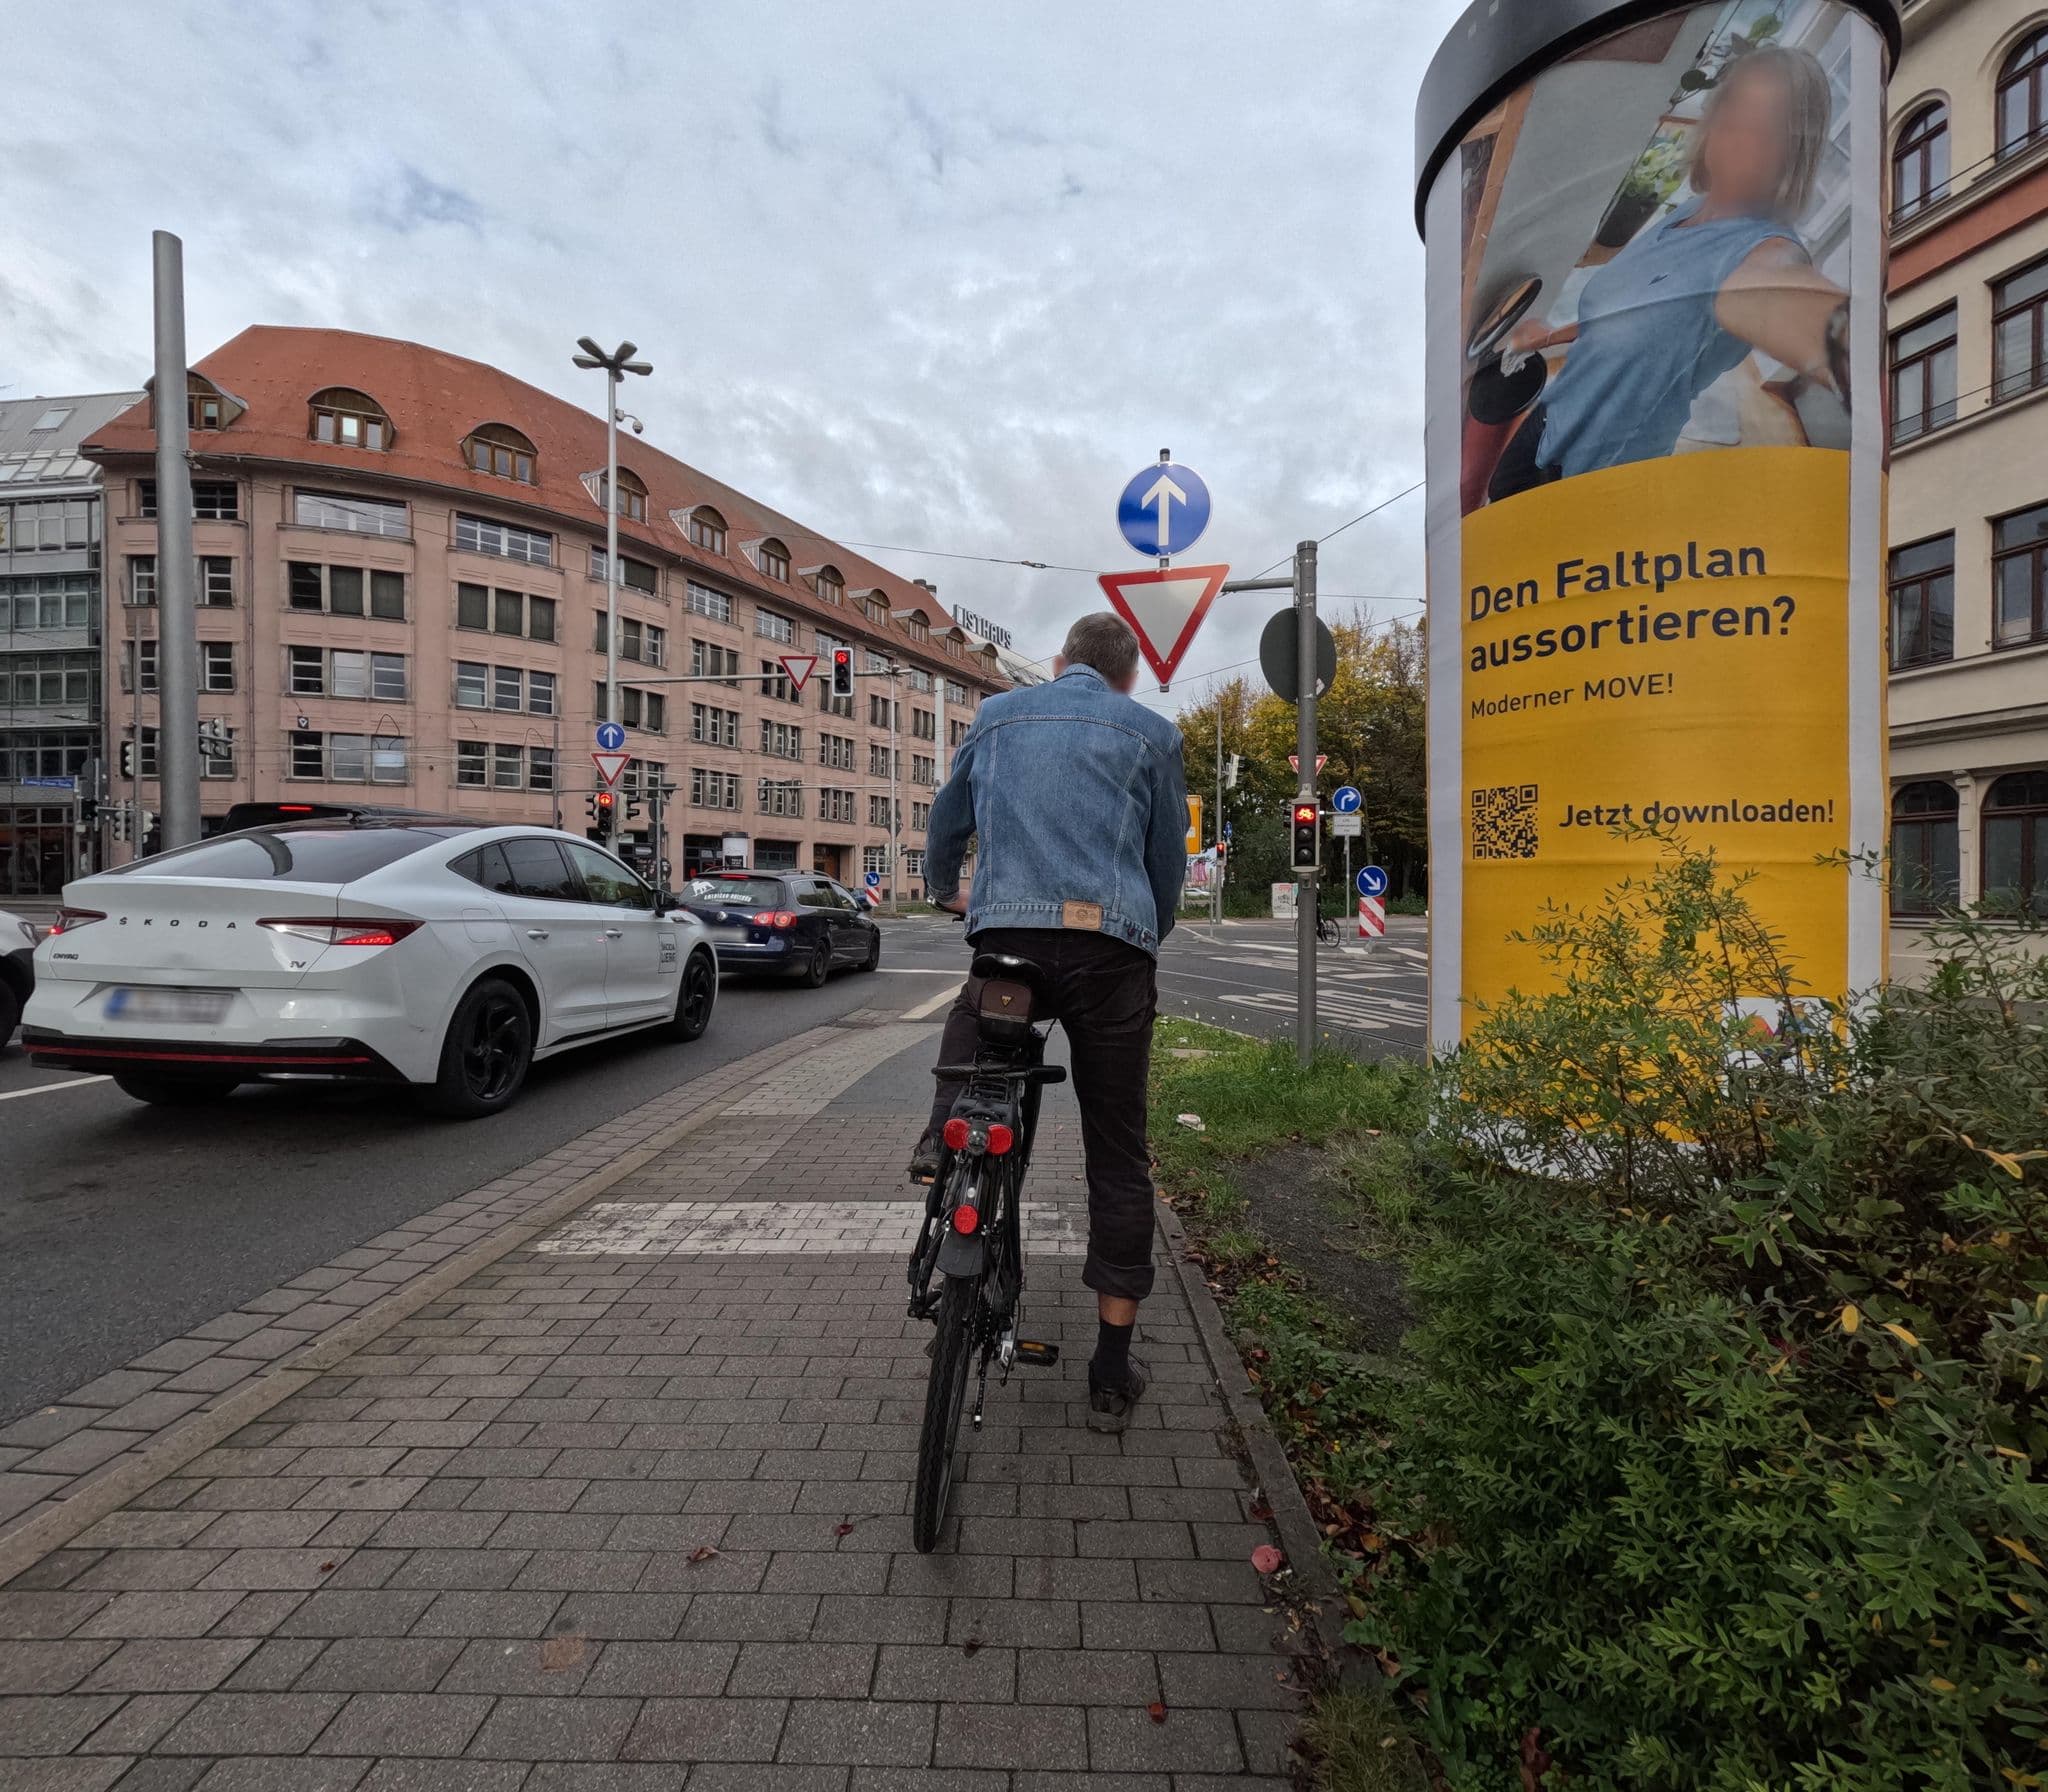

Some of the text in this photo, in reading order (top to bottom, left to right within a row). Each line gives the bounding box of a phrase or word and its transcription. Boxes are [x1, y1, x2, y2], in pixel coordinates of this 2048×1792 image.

[1470, 541, 1767, 622] Den Faltplan
[953, 604, 1012, 650] LISTHAUS
[1470, 595, 1796, 672] aussortieren?
[1471, 672, 1674, 719] Moderner MOVE!
[1559, 798, 1834, 828] Jetzt downloaden!
